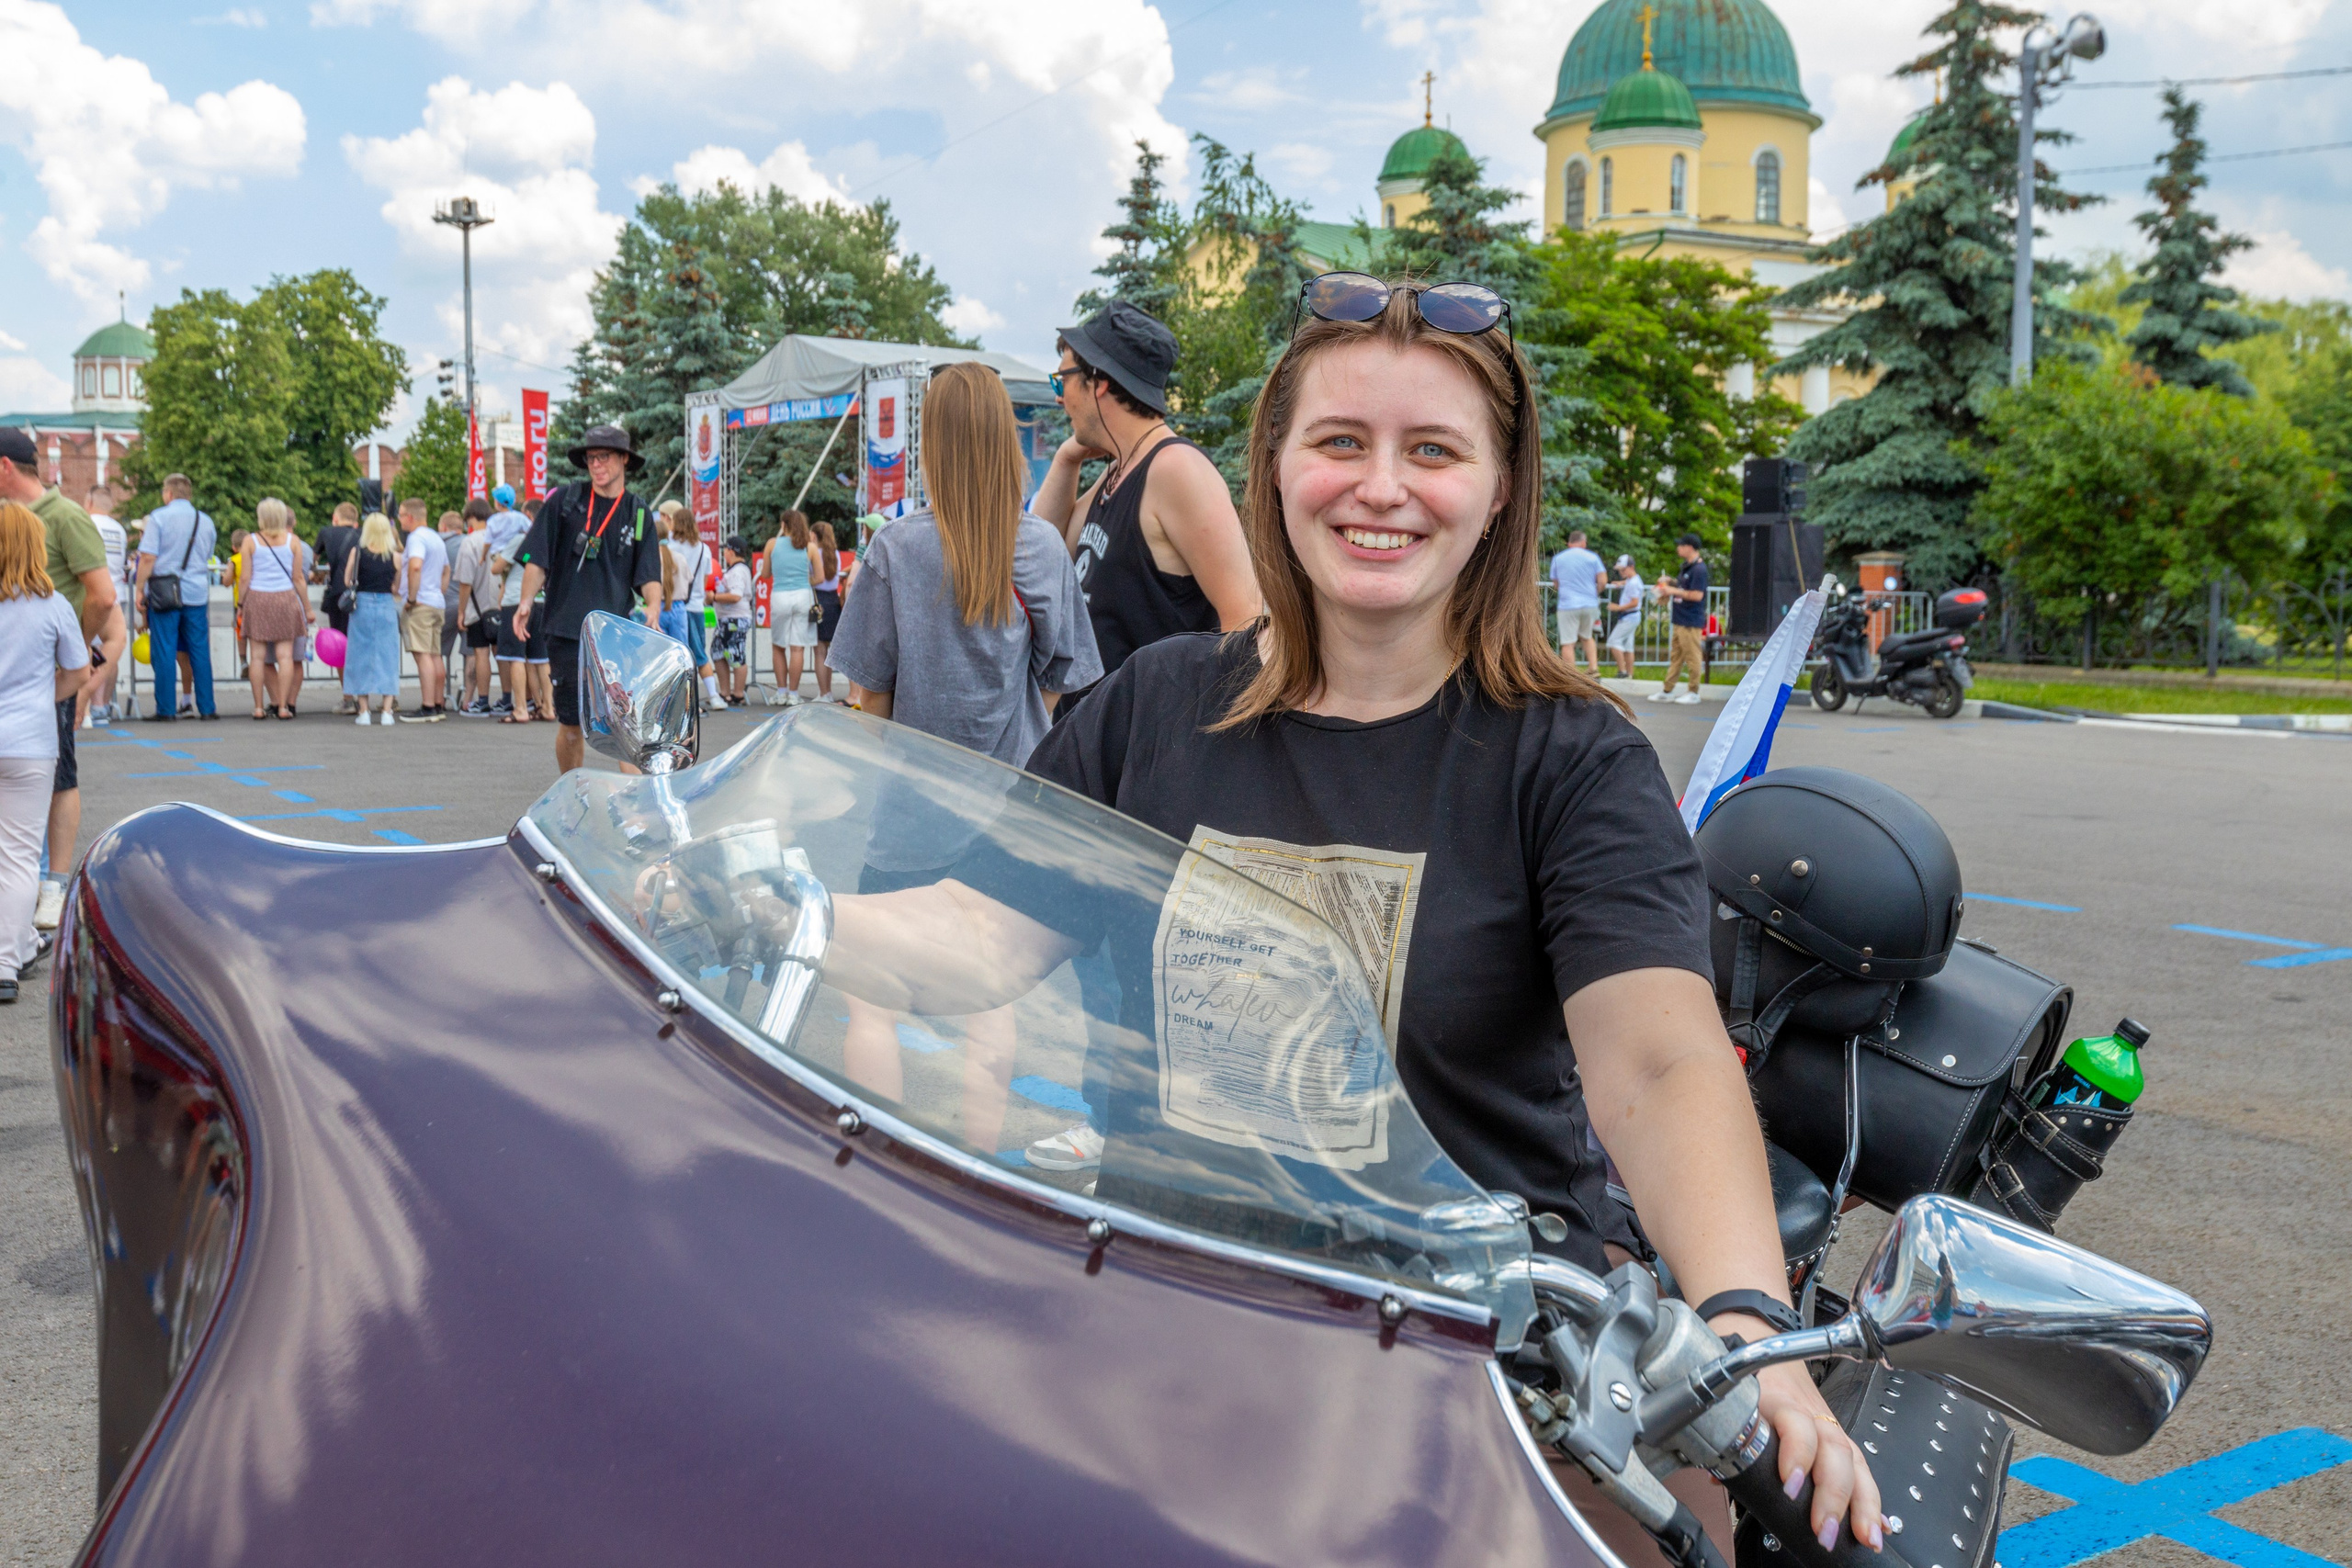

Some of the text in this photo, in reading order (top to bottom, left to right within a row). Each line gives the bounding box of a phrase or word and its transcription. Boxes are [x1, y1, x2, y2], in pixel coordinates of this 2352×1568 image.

[1180, 928, 1278, 957] YOURSELF GET
[1171, 952, 1243, 967] TOGETHER
[1173, 1012, 1214, 1031] DREAM
